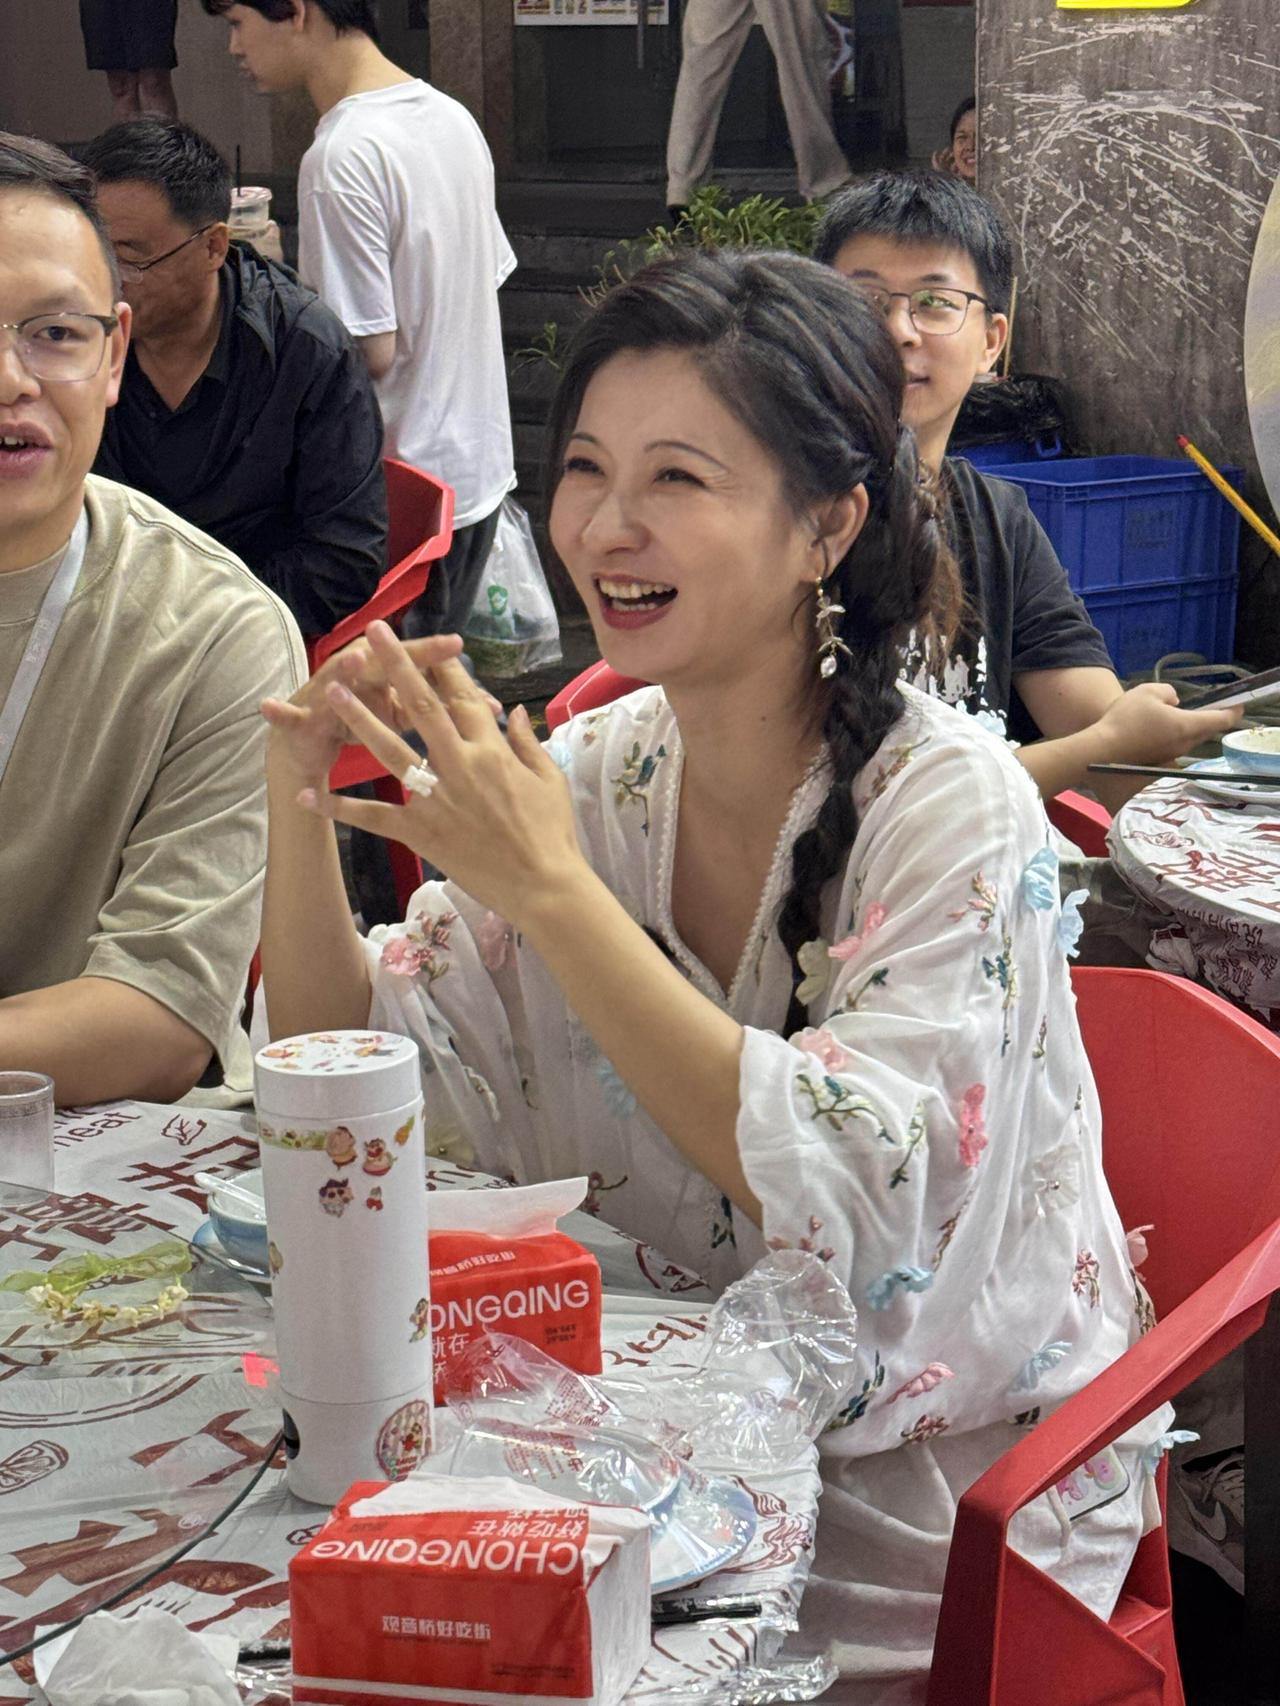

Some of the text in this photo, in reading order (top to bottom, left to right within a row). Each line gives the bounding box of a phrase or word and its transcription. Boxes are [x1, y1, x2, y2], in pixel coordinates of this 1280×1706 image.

[468, 1520, 586, 1539] 好吃就在
[310, 1536, 580, 1576] CHONGQING
[382, 1615, 491, 1640] 观音桥好吃街
